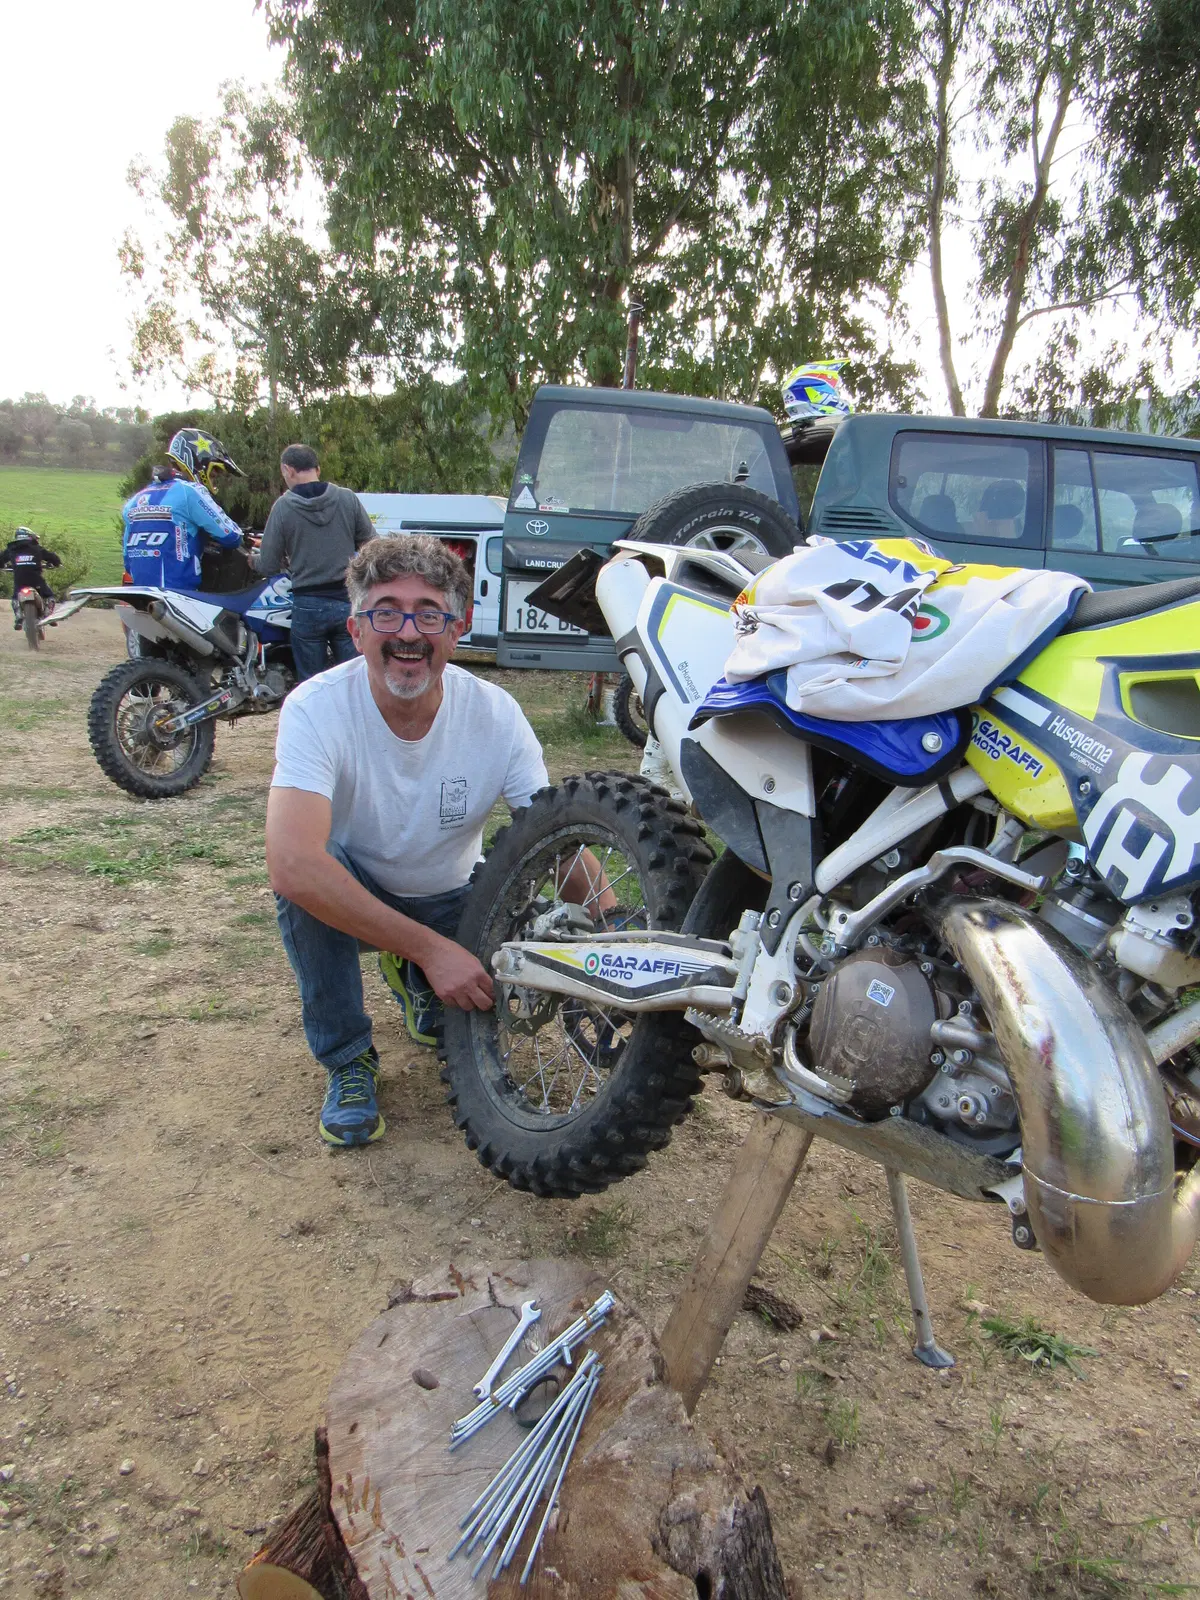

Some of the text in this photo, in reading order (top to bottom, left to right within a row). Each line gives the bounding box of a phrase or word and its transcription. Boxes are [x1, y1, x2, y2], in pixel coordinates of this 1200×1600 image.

[525, 559, 546, 568] LAND
[516, 608, 549, 630] 184
[681, 669, 701, 700] Husqvarna
[971, 733, 1001, 760] MOTO
[978, 720, 1044, 778] GARAFFI
[1047, 715, 1114, 764] Husqvarna
[1069, 751, 1103, 774] MOTORCYCLES
[599, 968, 633, 980] MOTO
[601, 953, 681, 977] GARAFFI
